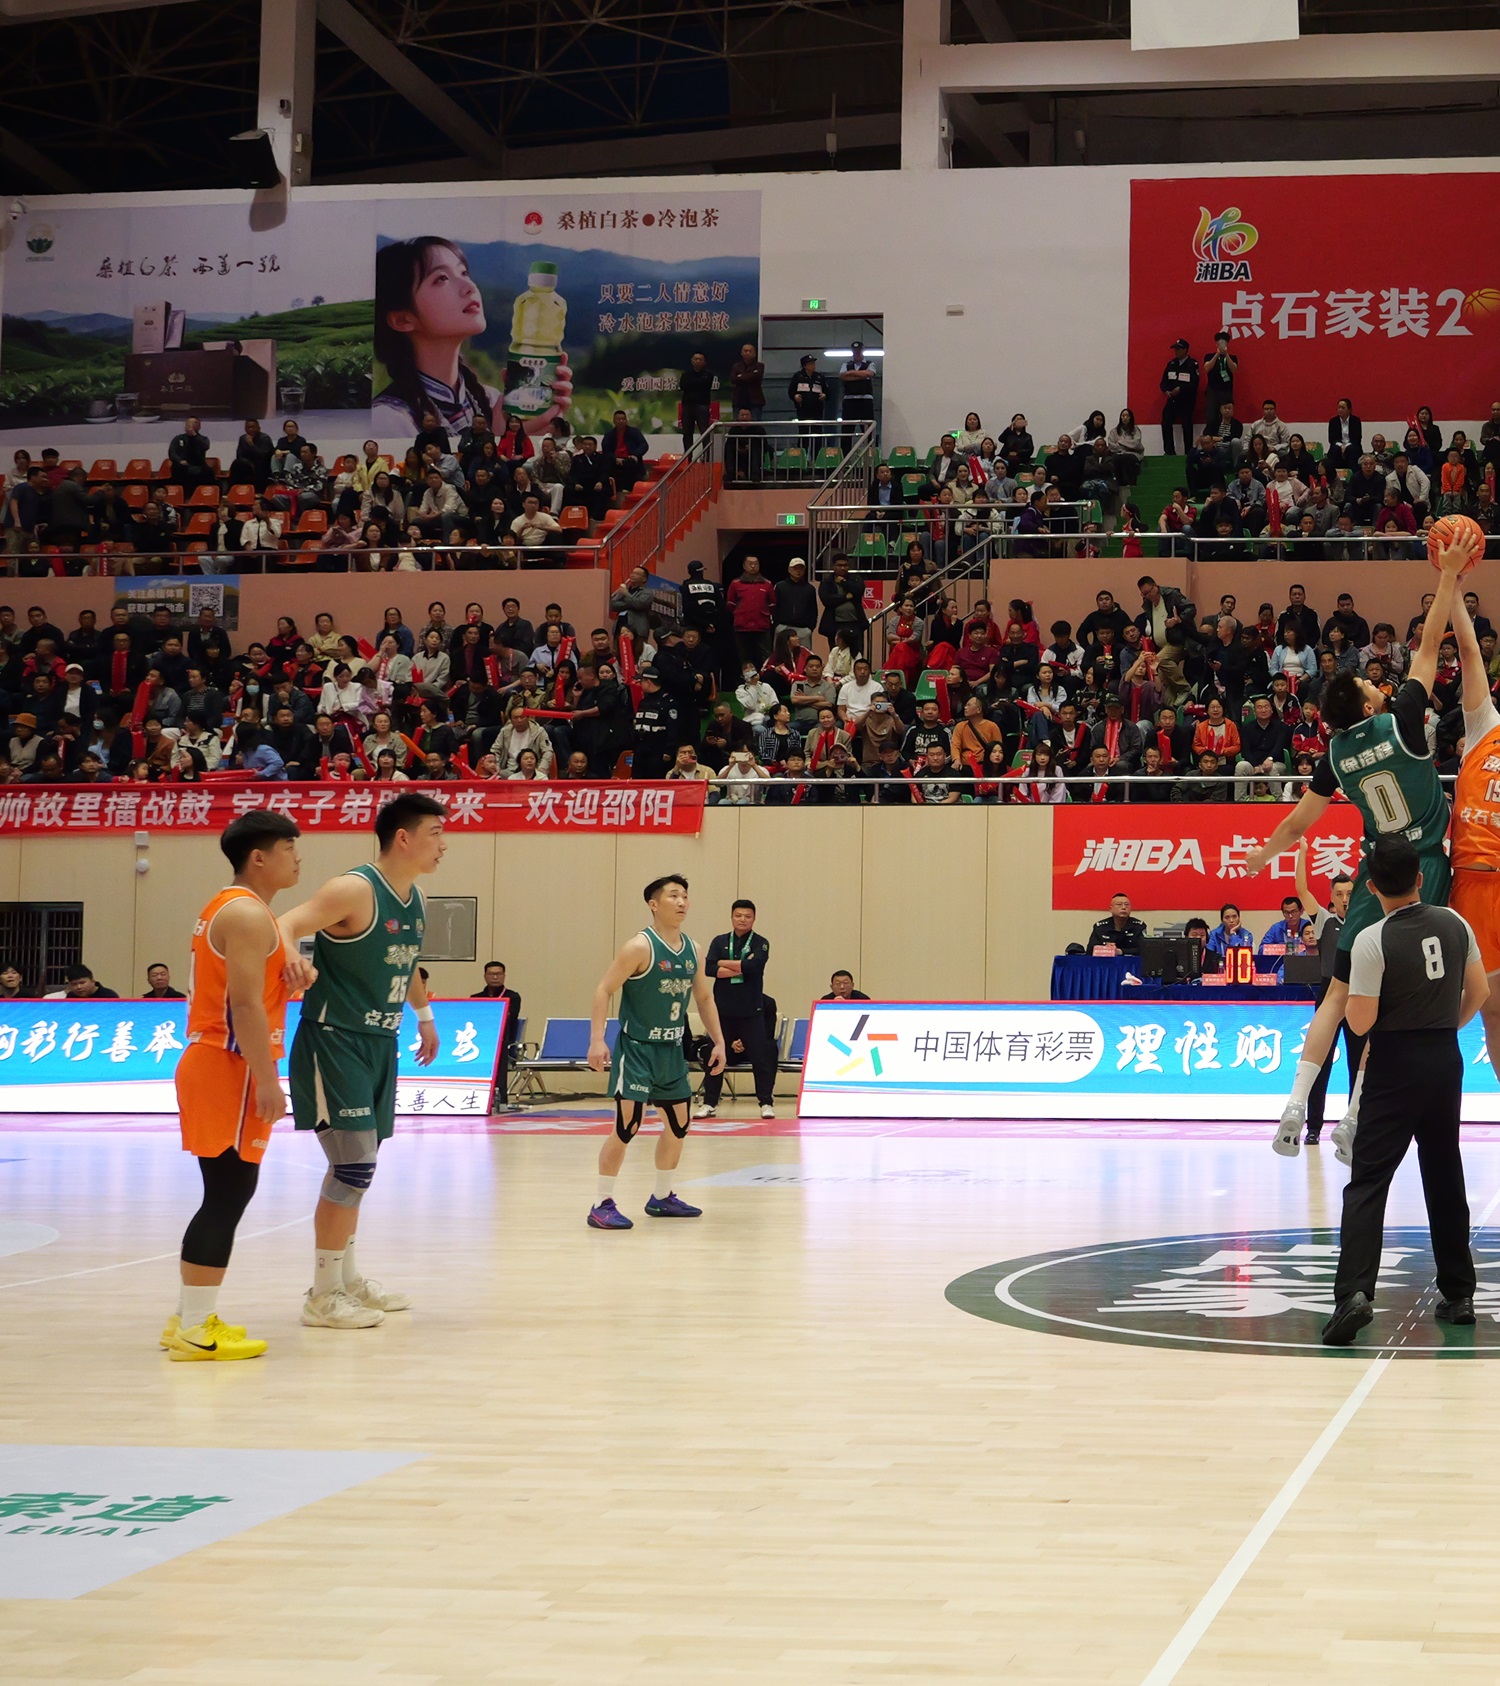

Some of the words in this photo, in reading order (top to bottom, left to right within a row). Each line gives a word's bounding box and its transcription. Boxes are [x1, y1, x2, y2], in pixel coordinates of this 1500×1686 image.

[1194, 260, 1252, 283] 湘BA
[598, 281, 730, 304] 只要二人情意好
[598, 310, 730, 333] 冷水泡茶慢慢浓
[1358, 769, 1414, 835] 0
[1074, 838, 1206, 878] 湘BA
[1421, 935, 1446, 981] 8
[387, 975, 408, 1004] 25
[912, 1028, 1096, 1063] 中国体育彩票
[0, 1523, 161, 1538] EWAY
